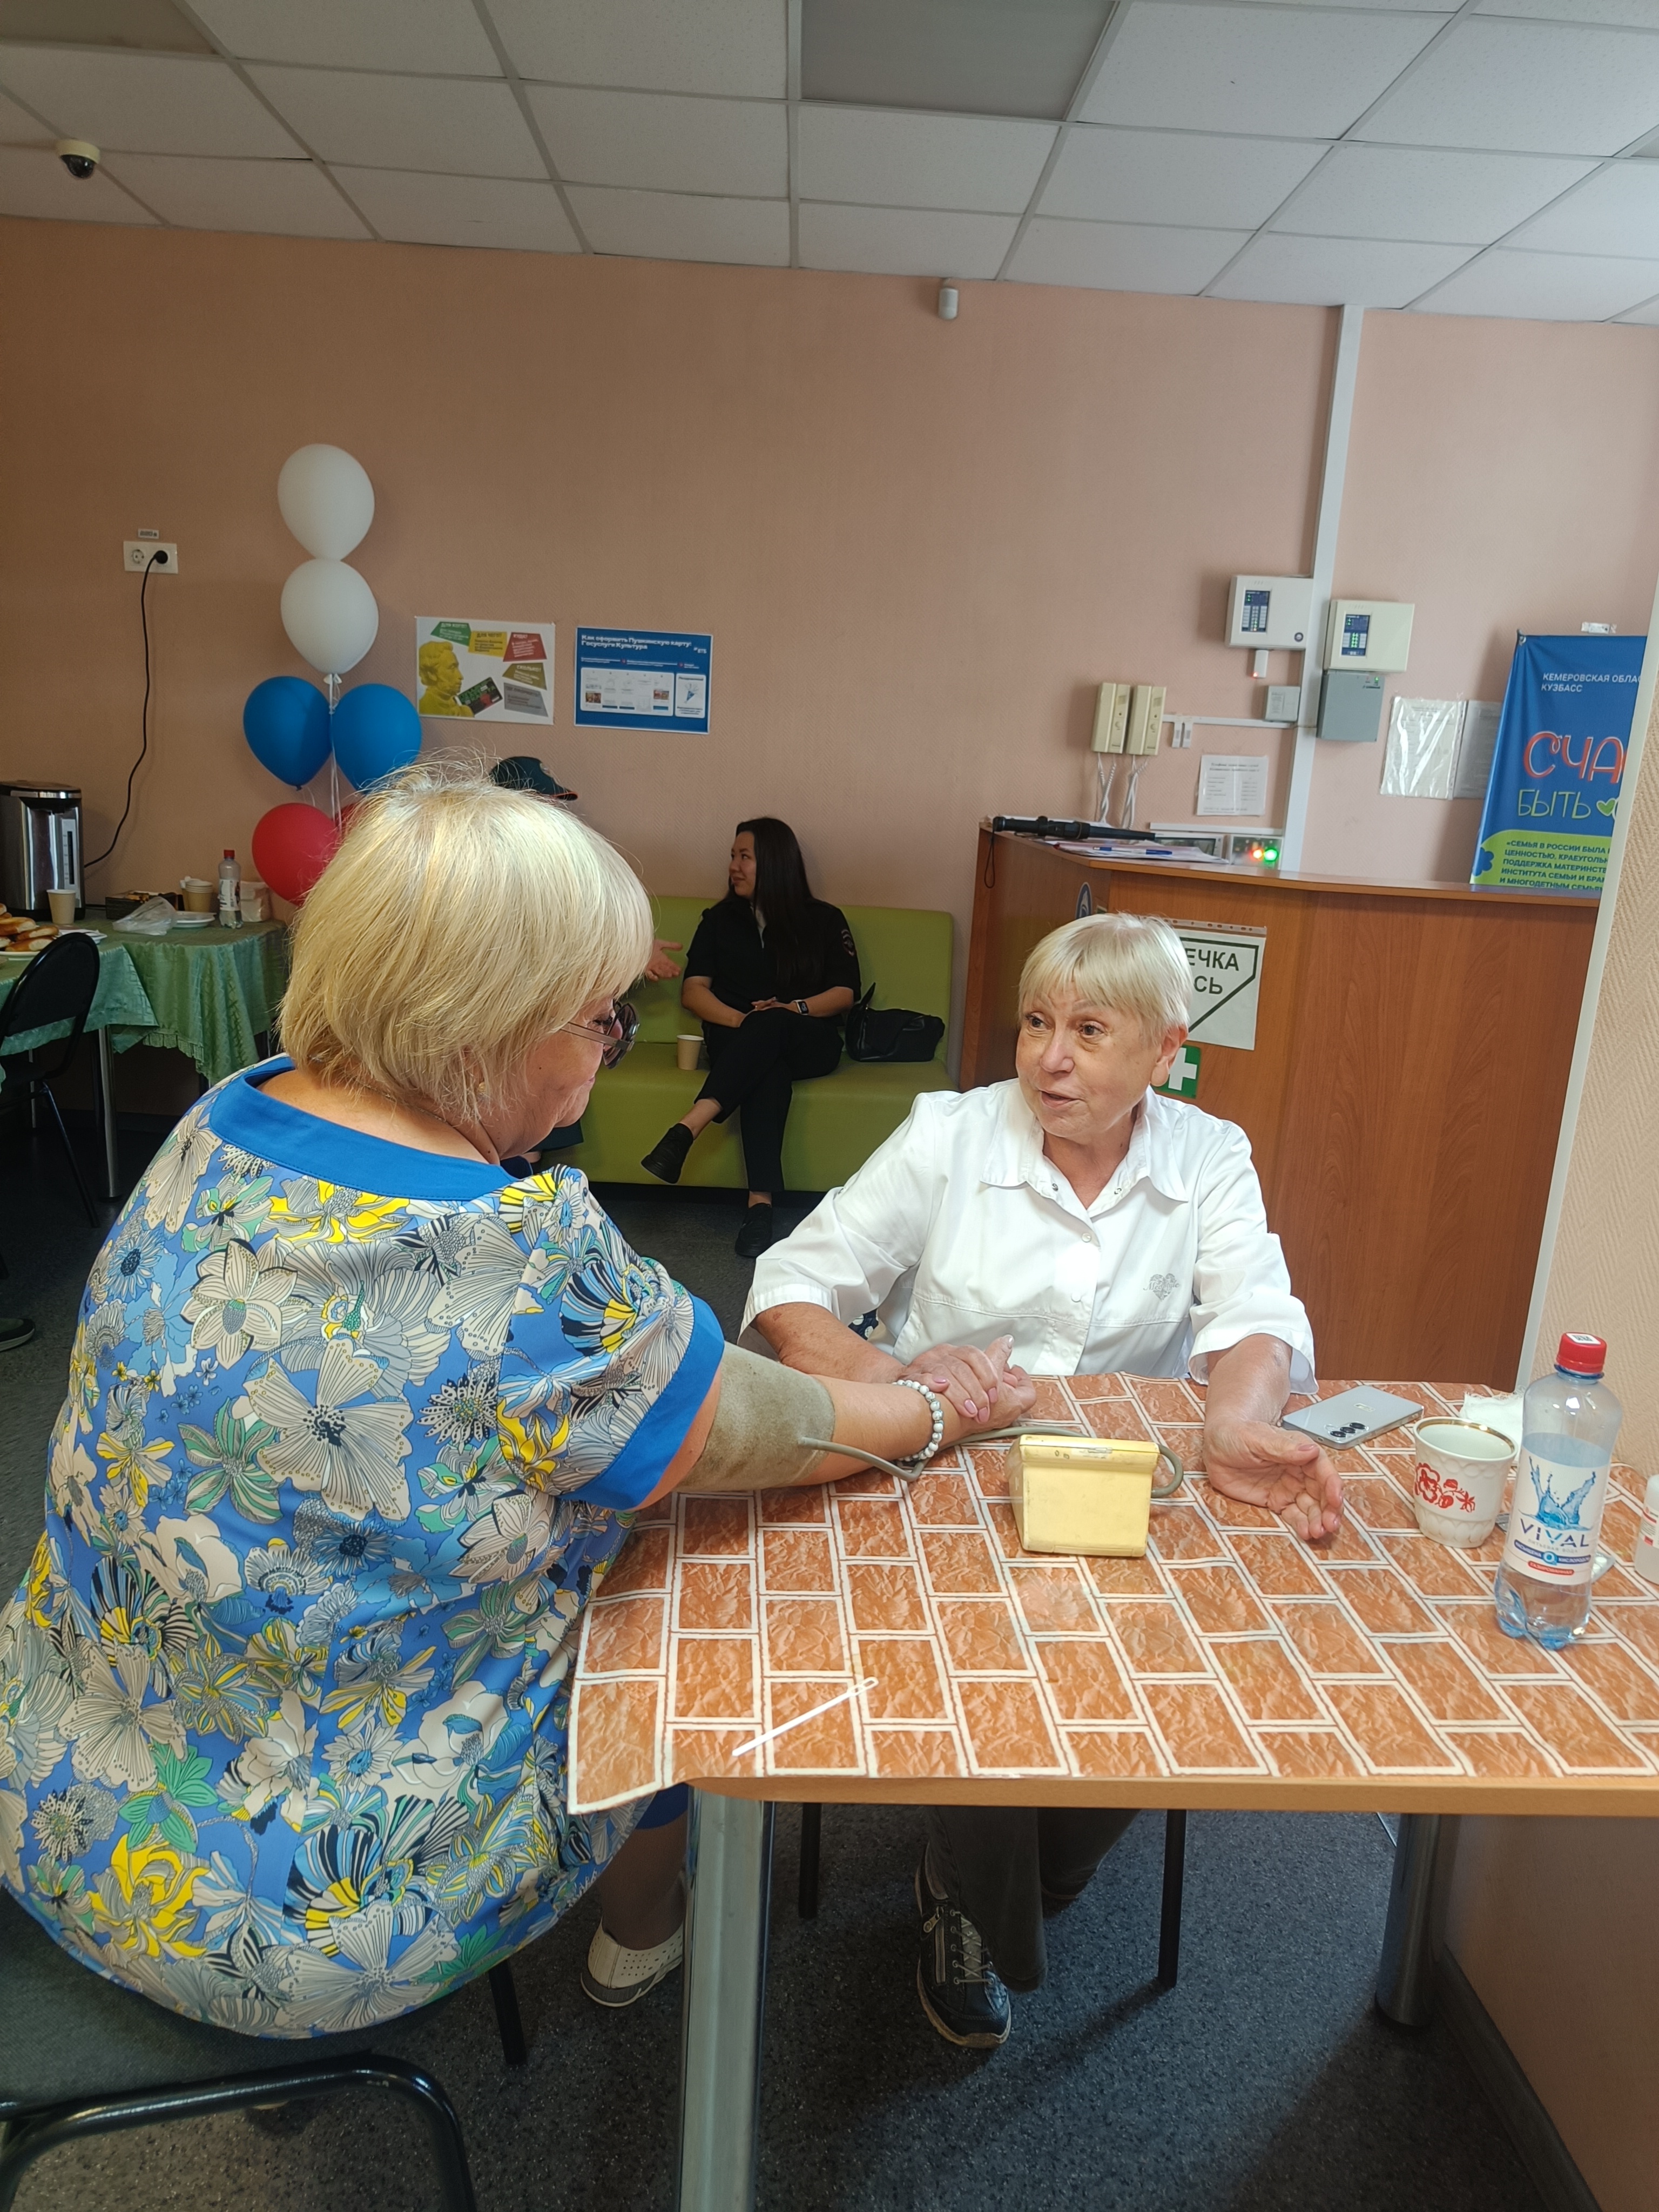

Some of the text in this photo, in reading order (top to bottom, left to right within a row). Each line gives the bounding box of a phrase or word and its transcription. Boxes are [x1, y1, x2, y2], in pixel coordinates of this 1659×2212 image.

[1543, 673, 1610, 682] КЕМЕРОВСКАЯ
[1541, 683, 1583, 692] КУЗБАСС
[1523, 731, 1627, 784] СЧА
[1518, 790, 1591, 819] БЫТЬ
[1507, 840, 1538, 848] «СЕМЬЯ
[1546, 844, 1581, 852] РОССИИ
[1503, 859, 1552, 869] ПОДДЕРЖКА
[1501, 868, 1547, 878] ИНСТИТУТА
[1507, 878, 1569, 889] МНОГОДЕТНЫМ
